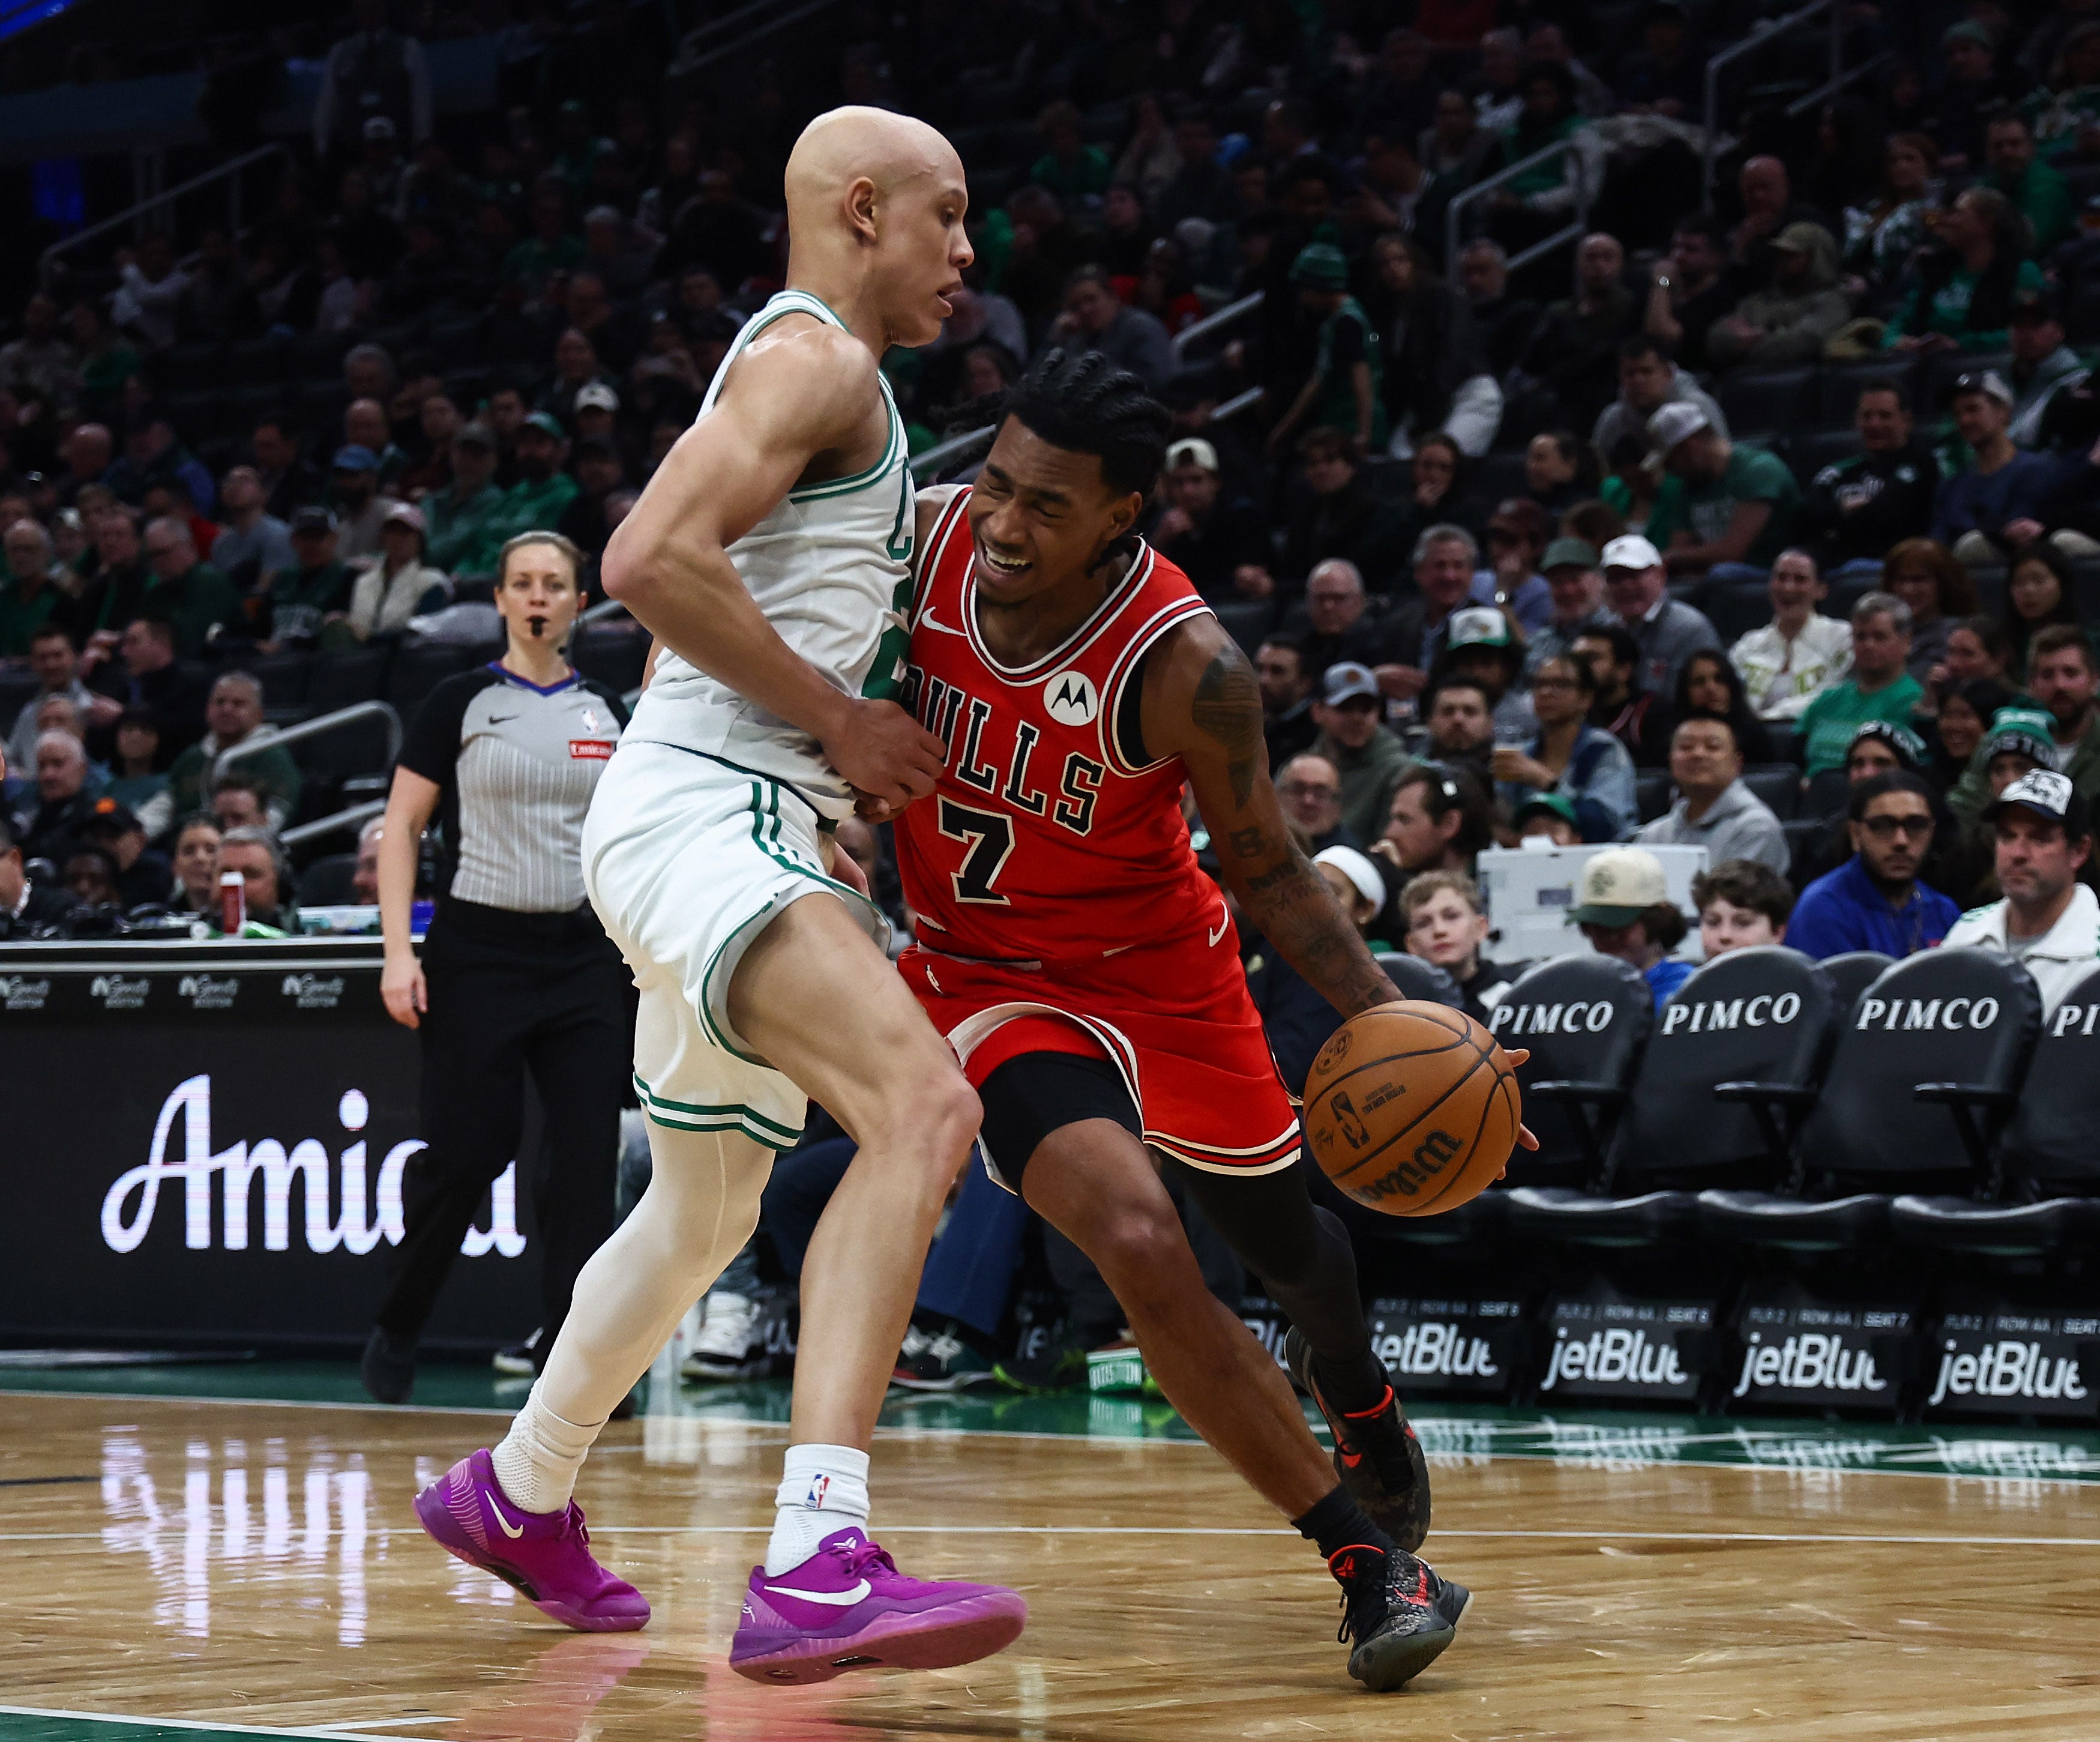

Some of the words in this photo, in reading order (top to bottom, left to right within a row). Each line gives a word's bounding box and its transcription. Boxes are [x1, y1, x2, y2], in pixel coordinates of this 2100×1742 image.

[937, 794, 1015, 906] 7
[1488, 1000, 1614, 1035] PIMCO
[1662, 992, 1801, 1035] PIMCO
[1856, 996, 2000, 1030] PIMCO
[1354, 1129, 1464, 1201] Wilso
[1928, 1338, 2089, 1406] jetBlue
